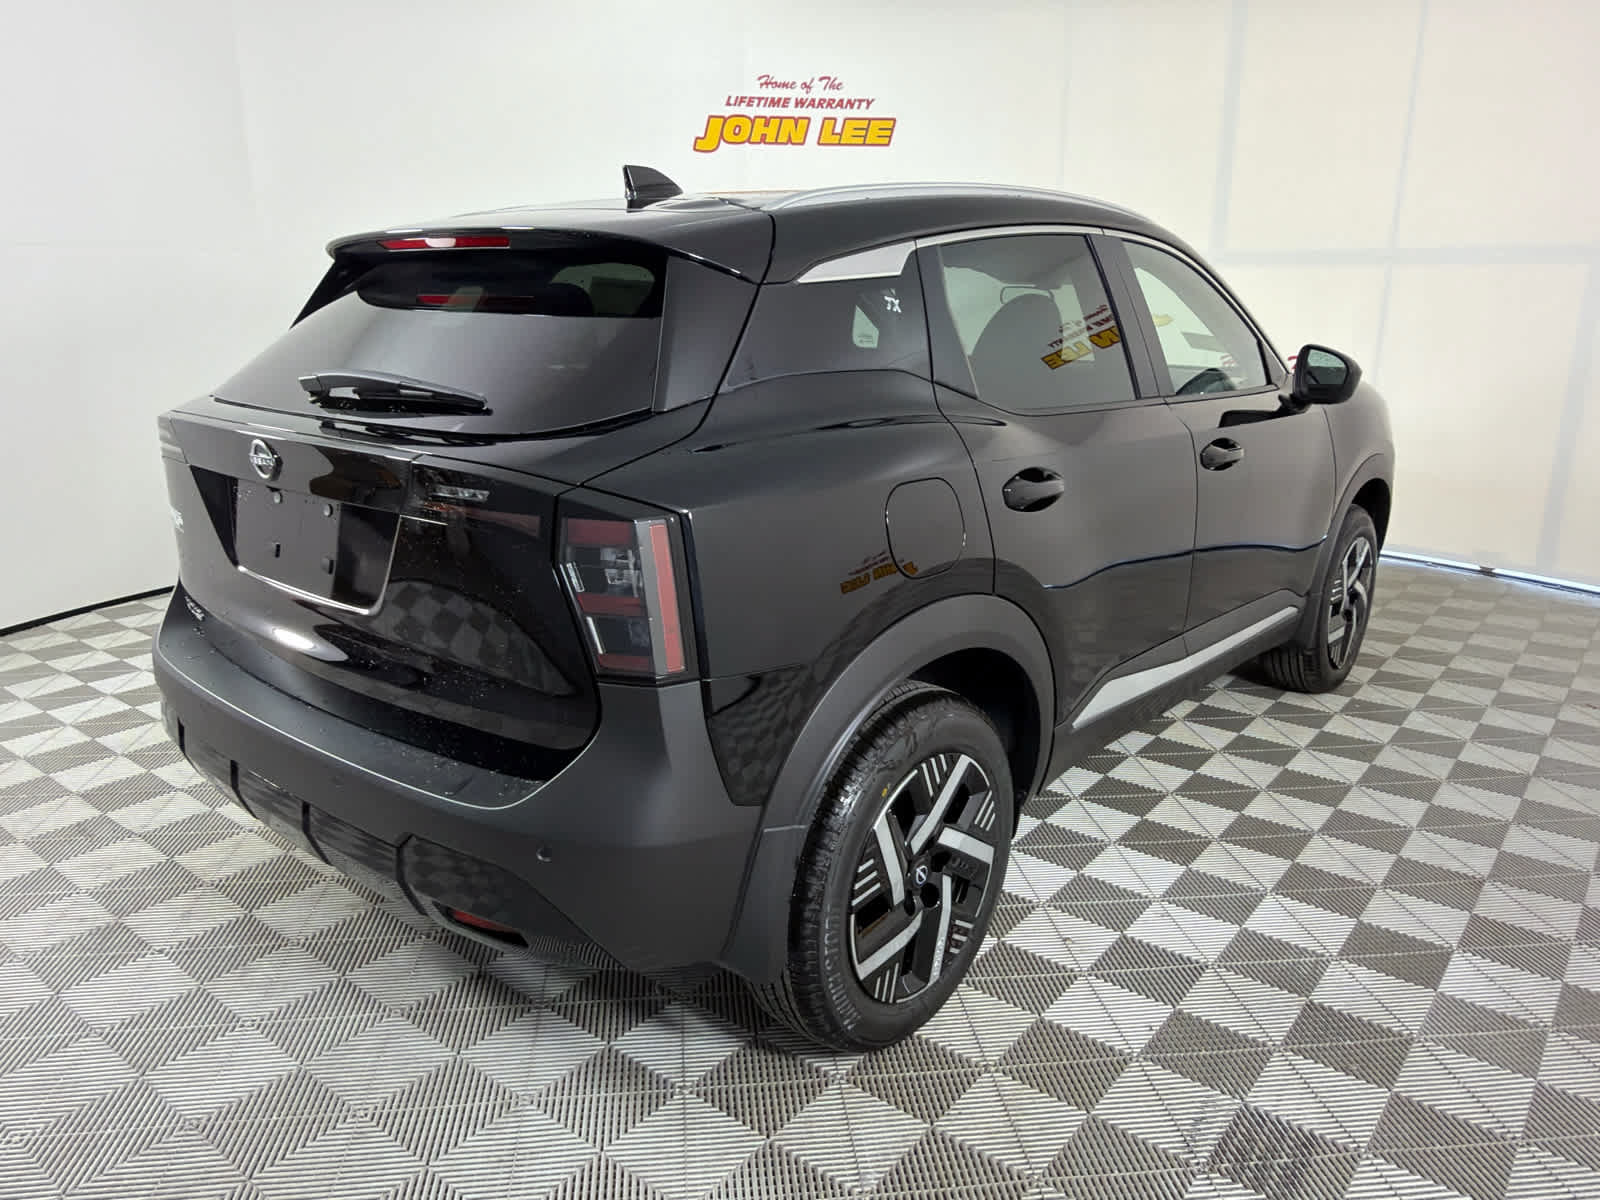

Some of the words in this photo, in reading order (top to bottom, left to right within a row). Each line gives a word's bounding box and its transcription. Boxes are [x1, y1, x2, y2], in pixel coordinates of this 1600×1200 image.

[757, 74, 798, 90] Home
[800, 77, 814, 94] of
[818, 76, 844, 91] The
[725, 96, 791, 109] LIFETIME
[794, 97, 875, 110] WARRANTY
[693, 114, 811, 152] JOHN
[817, 118, 896, 146] LEE
